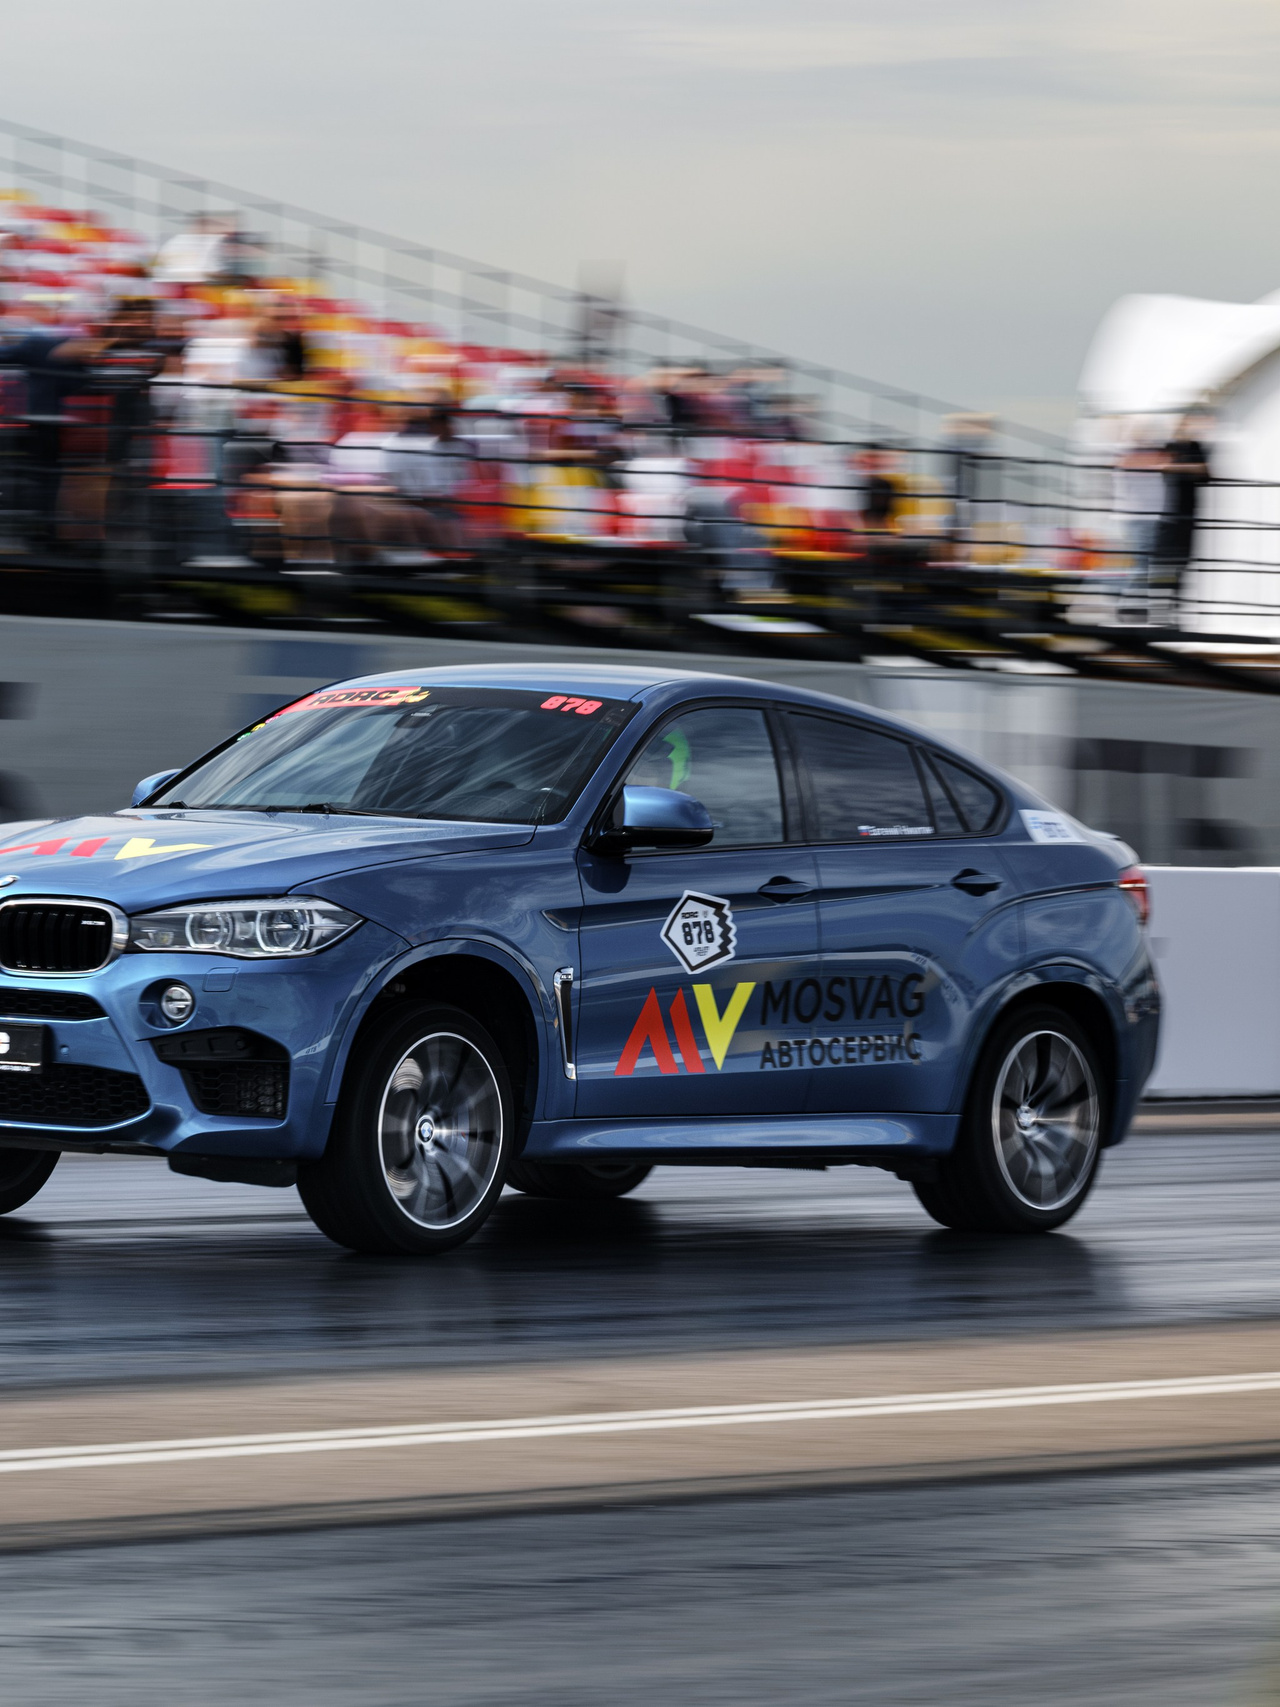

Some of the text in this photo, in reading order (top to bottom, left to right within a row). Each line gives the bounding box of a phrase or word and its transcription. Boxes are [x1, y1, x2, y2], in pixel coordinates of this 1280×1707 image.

[540, 695, 603, 715] 878
[682, 920, 715, 946] 878
[760, 973, 926, 1026] MOSVAG
[760, 1032, 923, 1069] АВТОСЕРВИС
